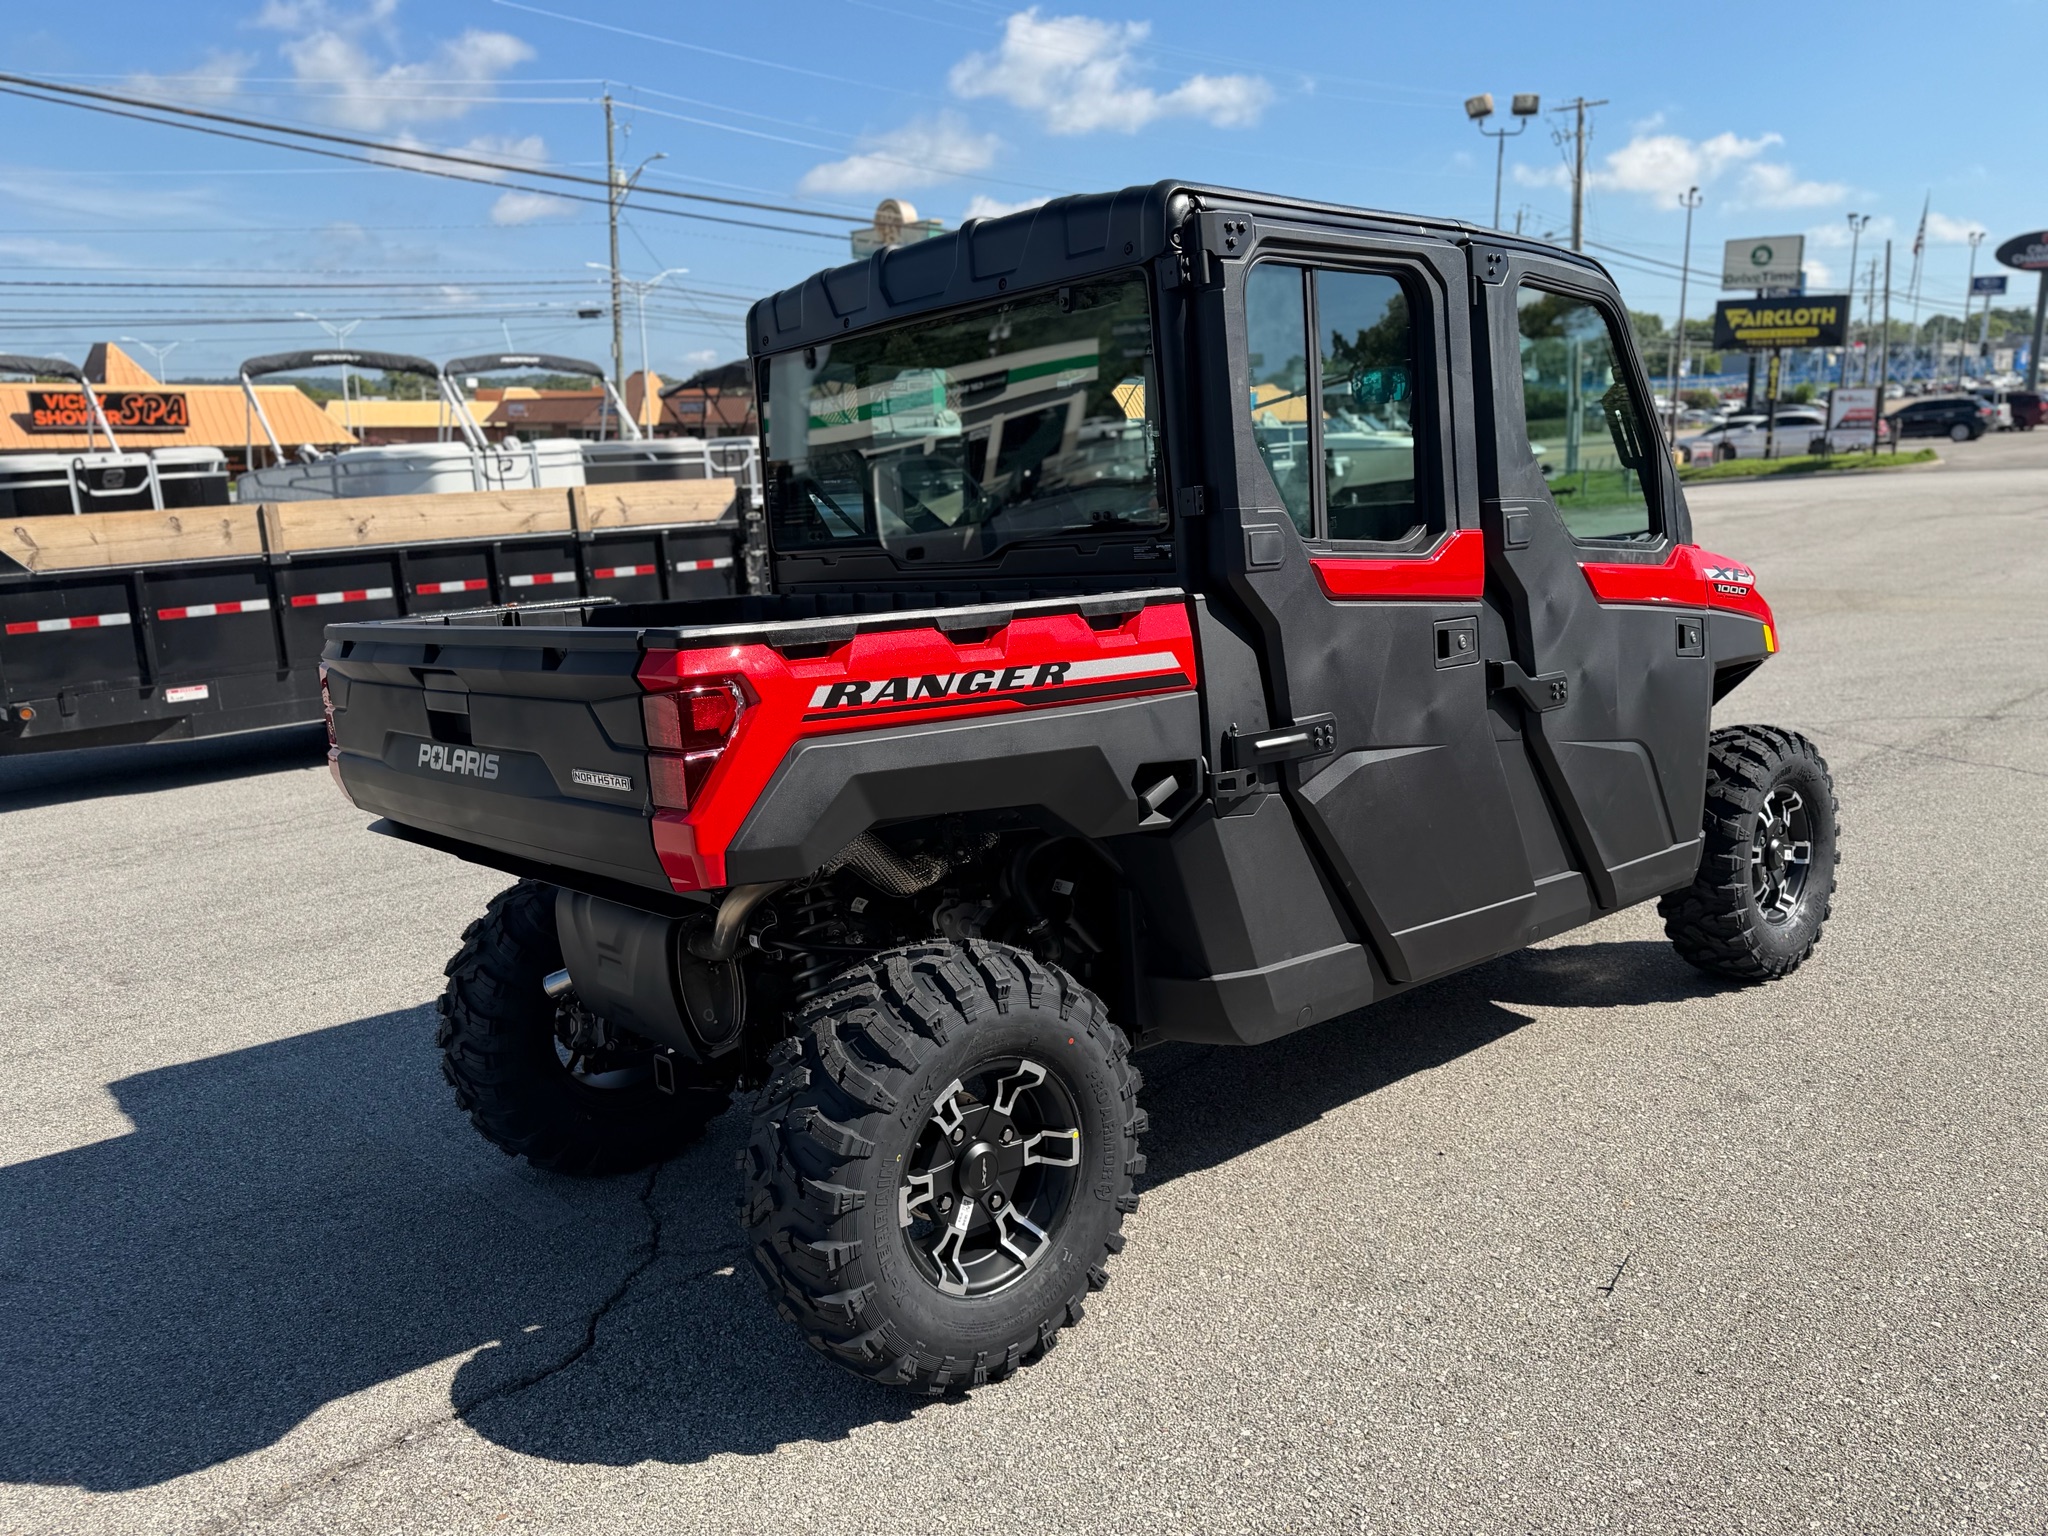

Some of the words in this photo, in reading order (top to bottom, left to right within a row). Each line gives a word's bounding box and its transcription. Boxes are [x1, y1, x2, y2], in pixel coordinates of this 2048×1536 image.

[1725, 307, 1836, 329] FAIRCLOTH
[121, 393, 188, 425] SPA
[1711, 564, 1750, 581] XP
[1717, 584, 1747, 595] 1000
[822, 661, 1071, 709] RANGER
[418, 743, 500, 780] POLARIS
[573, 770, 630, 790] NORTHSTAR
